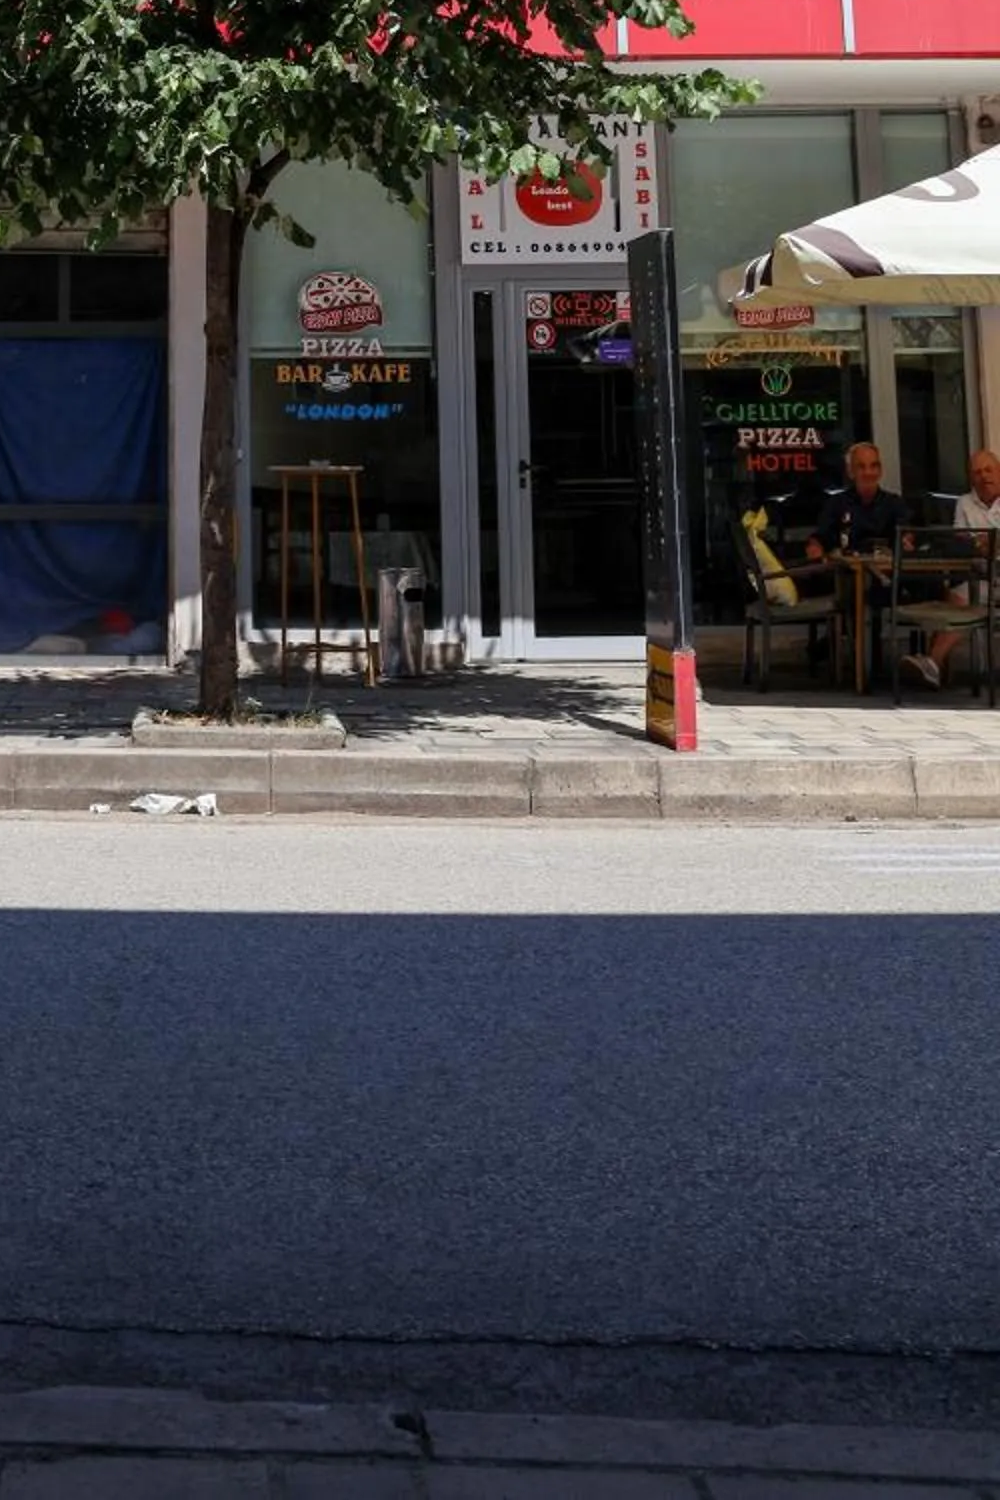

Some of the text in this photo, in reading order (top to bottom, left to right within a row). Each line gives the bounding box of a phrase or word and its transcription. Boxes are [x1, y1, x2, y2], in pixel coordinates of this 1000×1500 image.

[634, 143, 651, 229] SABI
[301, 338, 385, 357] PIZZA
[275, 363, 412, 384] BAR KAFE
[715, 402, 838, 422] GJELLTORE
[736, 427, 824, 448] PIZZA
[747, 453, 818, 472] HOTEL
